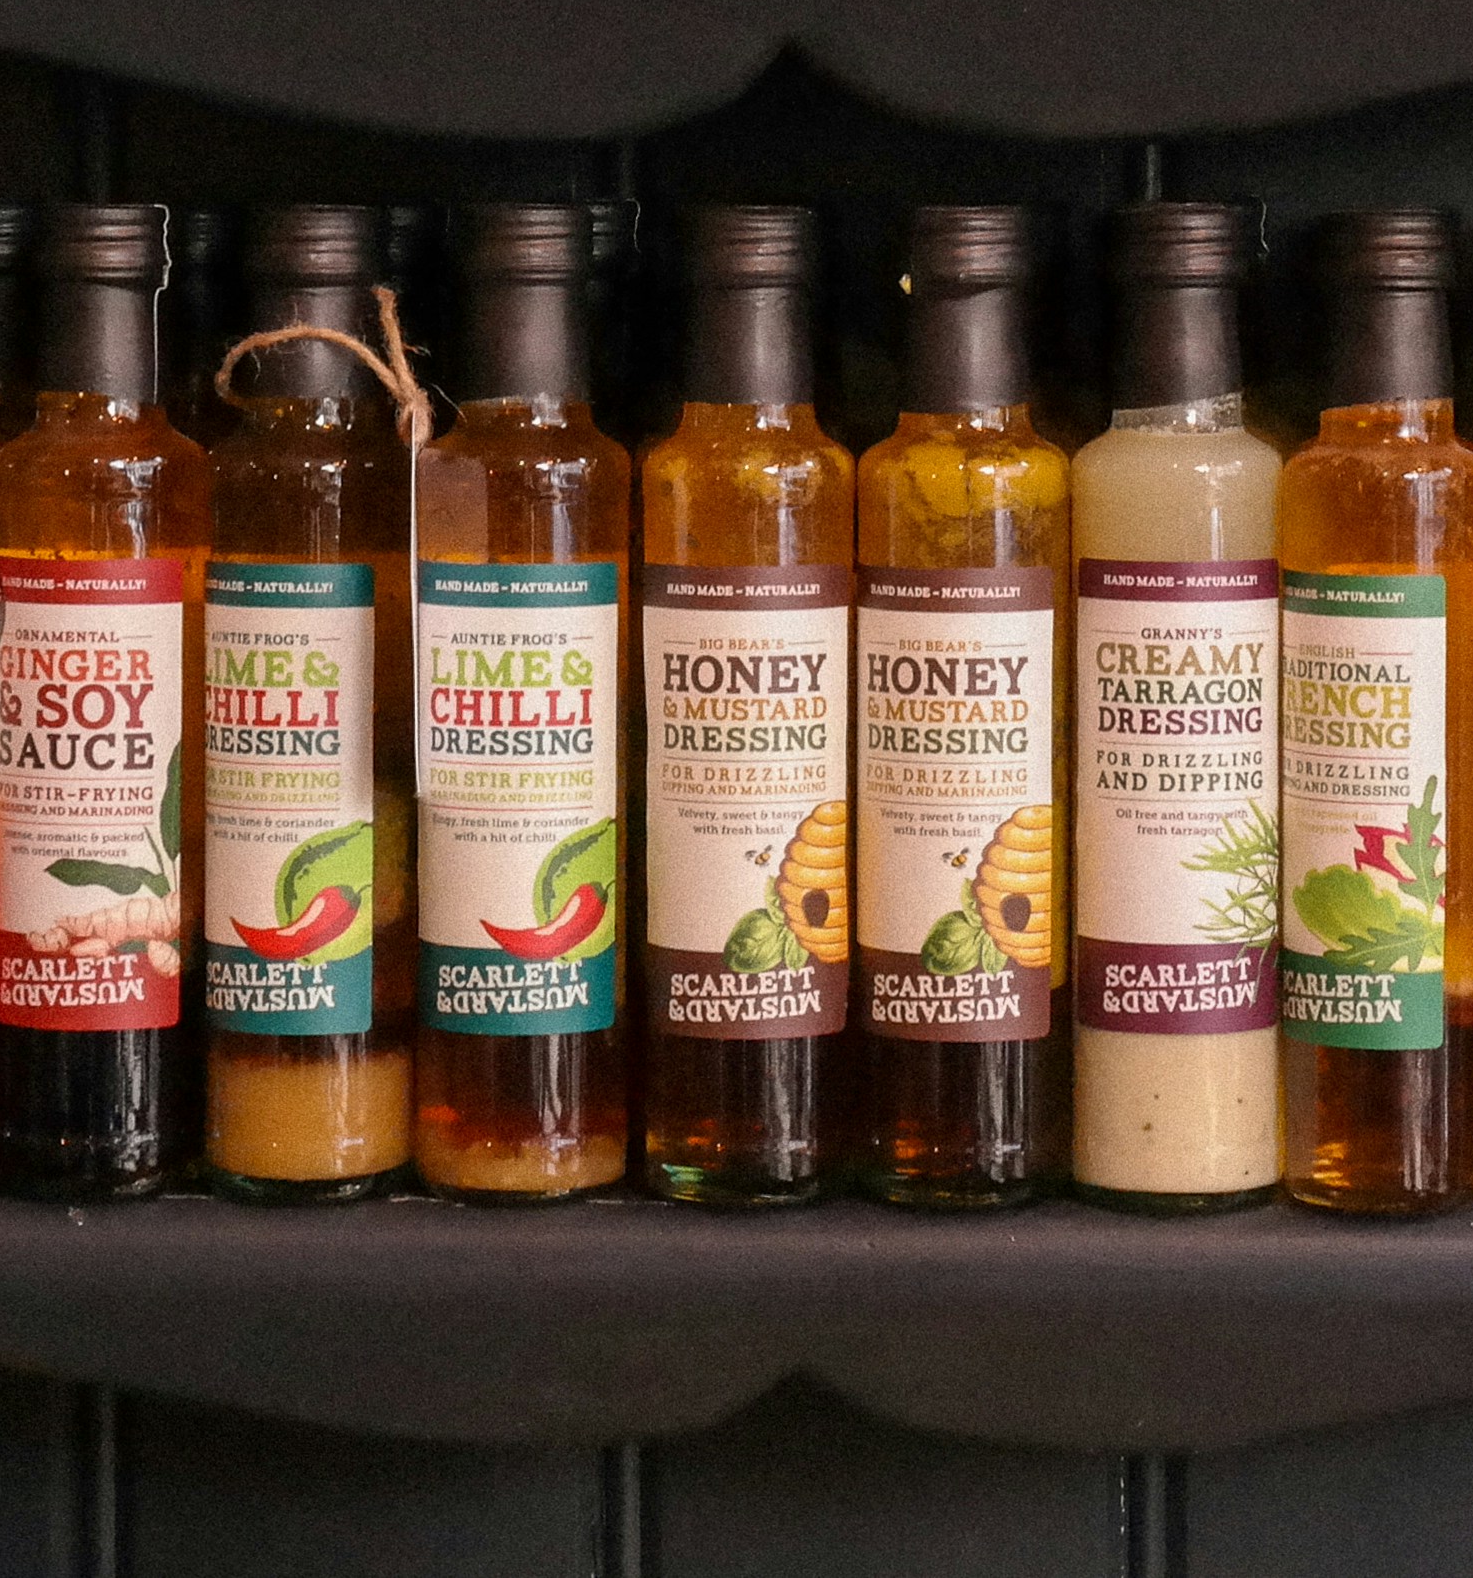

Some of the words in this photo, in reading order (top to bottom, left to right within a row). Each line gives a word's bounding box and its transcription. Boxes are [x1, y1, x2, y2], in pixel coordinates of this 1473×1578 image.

[1103, 573, 1135, 587] HAND
[1136, 575, 1175, 587] MADE
[1186, 574, 1258, 587] NATURALLY!
[14, 629, 121, 644] ORNAMENTAL
[451, 632, 506, 646] AUNTIE
[511, 632, 567, 646] FROG'S
[699, 638, 723, 651] BIG
[728, 638, 785, 651] BEAR'S
[1140, 626, 1223, 640] GRANNY'S
[1095, 642, 1264, 676] CREAMY
[1299, 644, 1356, 659] ENGLISH
[0, 649, 154, 683] GINGER
[430, 649, 553, 688] LIME
[560, 649, 592, 687] &
[663, 653, 827, 695] HONEY
[866, 654, 1029, 697] HONEY
[1098, 678, 1263, 705] TARRAGON
[0, 682, 23, 728] &
[36, 683, 155, 730] SOY
[430, 688, 592, 728] CHILLI
[663, 697, 679, 717] &
[684, 696, 827, 721] MUSTARD
[867, 698, 881, 717] &
[884, 698, 1029, 724] MUSTARD
[1098, 707, 1263, 735] DRESSING
[430, 726, 594, 756] DRESSING
[663, 723, 827, 753] DRESSING
[867, 726, 1029, 756] DRESSING
[1096, 749, 1131, 767] FOR
[1142, 750, 1263, 768] DRIZZLING
[1295, 761, 1410, 781] DRIZZLING
[23, 785, 154, 803] STIR-FRYING
[1096, 771, 1148, 792] AND
[1158, 770, 1263, 792] DIPPING
[1, 954, 138, 981] SCARLETT
[438, 960, 583, 988] SCARLETT
